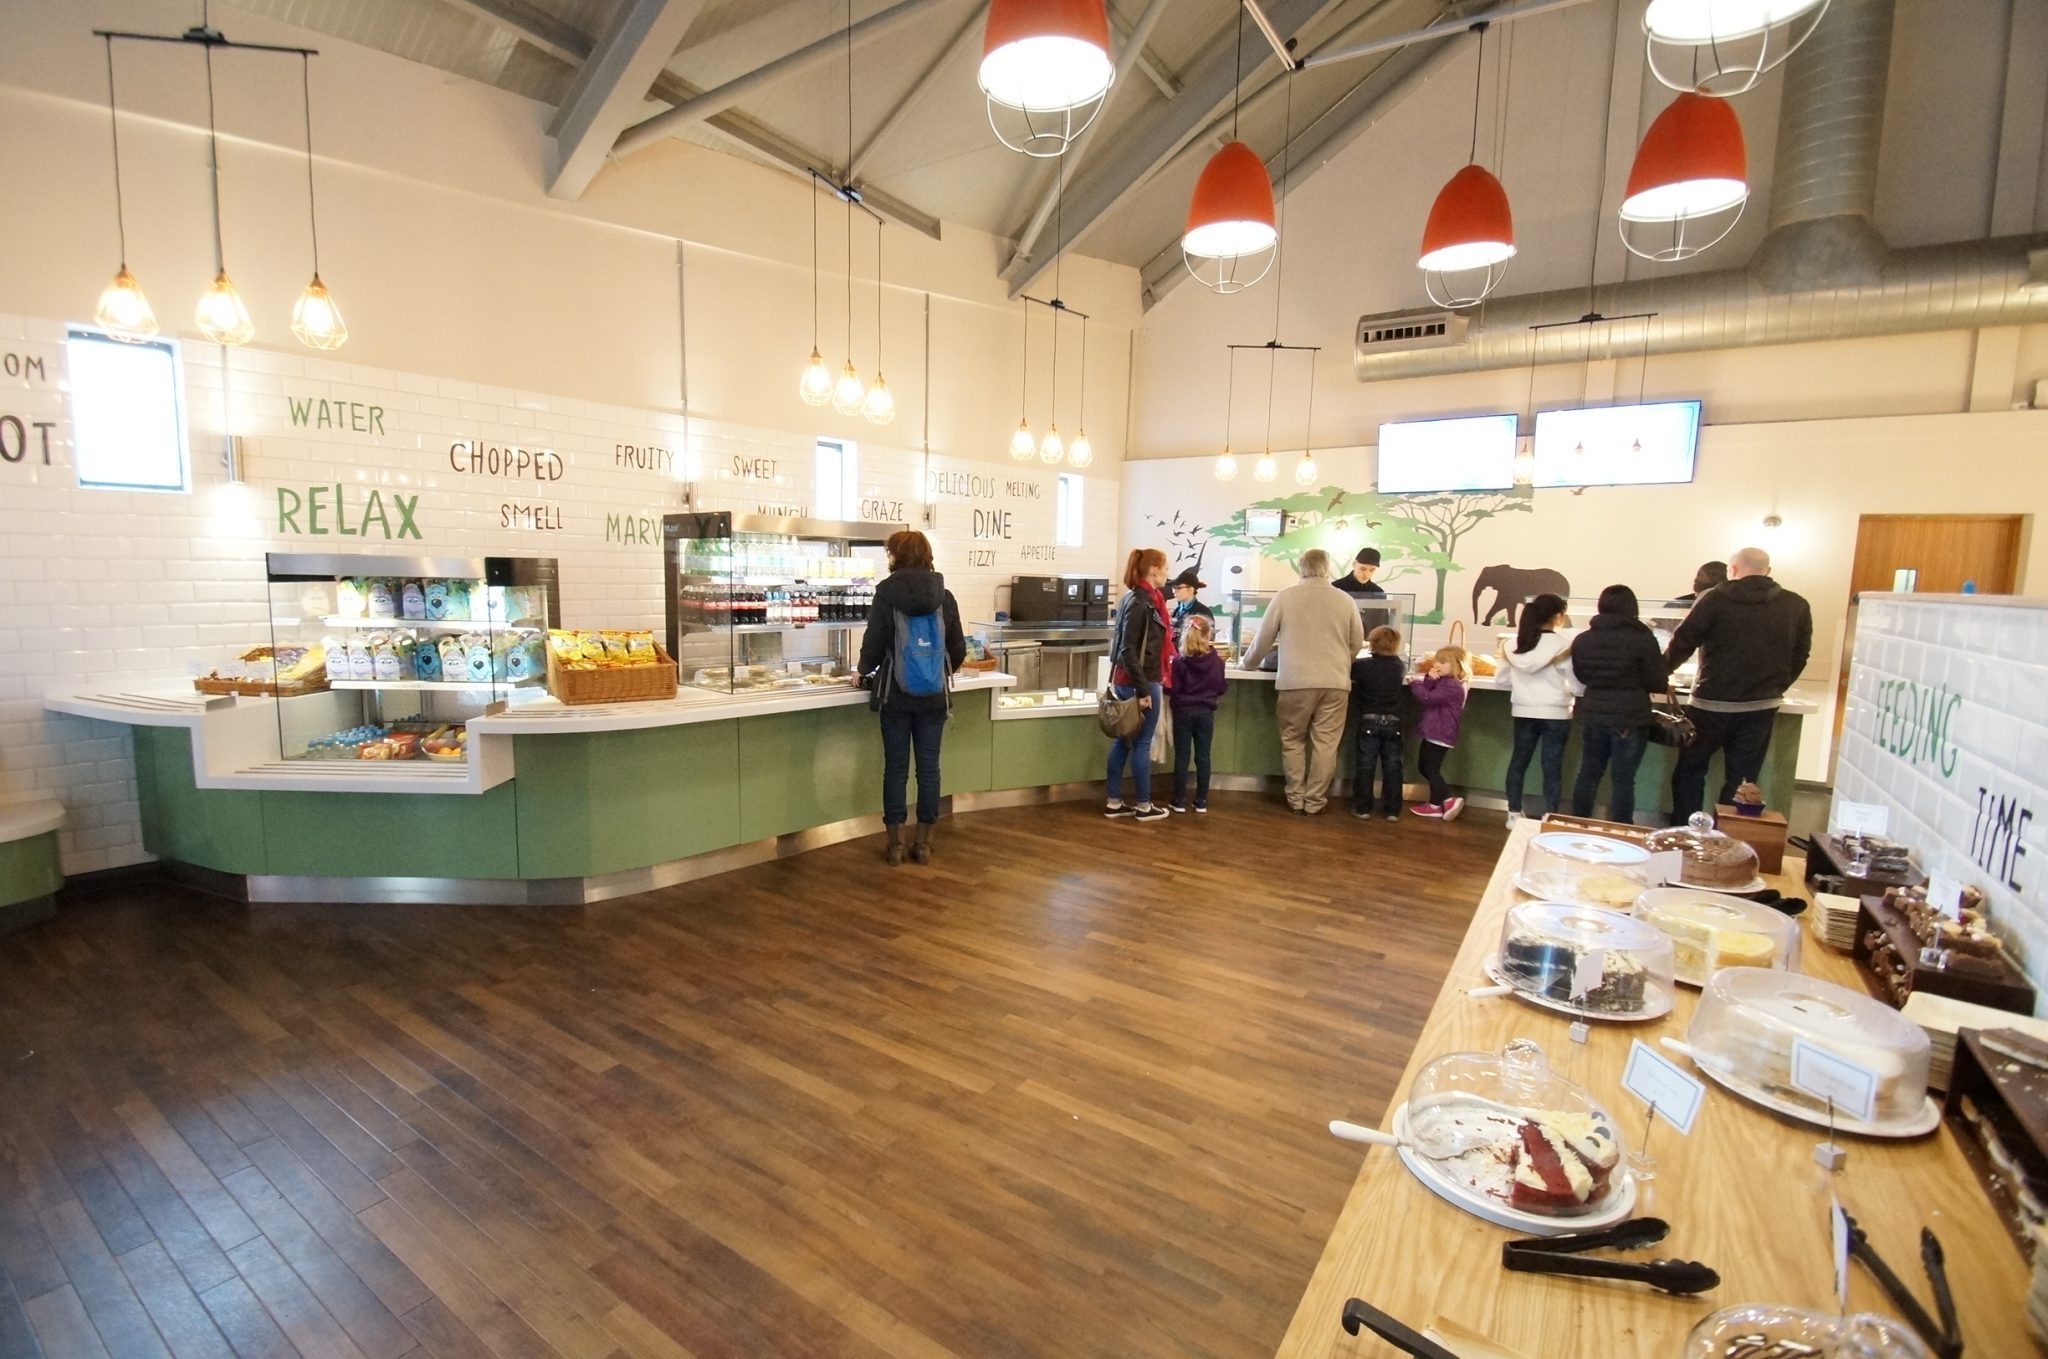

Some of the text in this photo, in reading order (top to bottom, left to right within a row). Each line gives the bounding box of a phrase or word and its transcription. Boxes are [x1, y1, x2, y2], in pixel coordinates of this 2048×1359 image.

[288, 396, 385, 436] WATER
[450, 440, 564, 481] CHOPPED
[616, 444, 675, 472] FRUITY
[733, 455, 778, 479] SWEET
[928, 470, 996, 499] DELICIOUS
[1005, 481, 1041, 499] MELTING
[277, 483, 423, 540] RELAX
[500, 503, 563, 530] SMELL
[861, 499, 904, 522] GRAZE
[973, 509, 1012, 539] DINE
[968, 550, 996, 567] FIZZY
[1020, 545, 1056, 561] APPETITE
[1872, 680, 1962, 778] FEEDING
[1971, 786, 2033, 893] TIME
